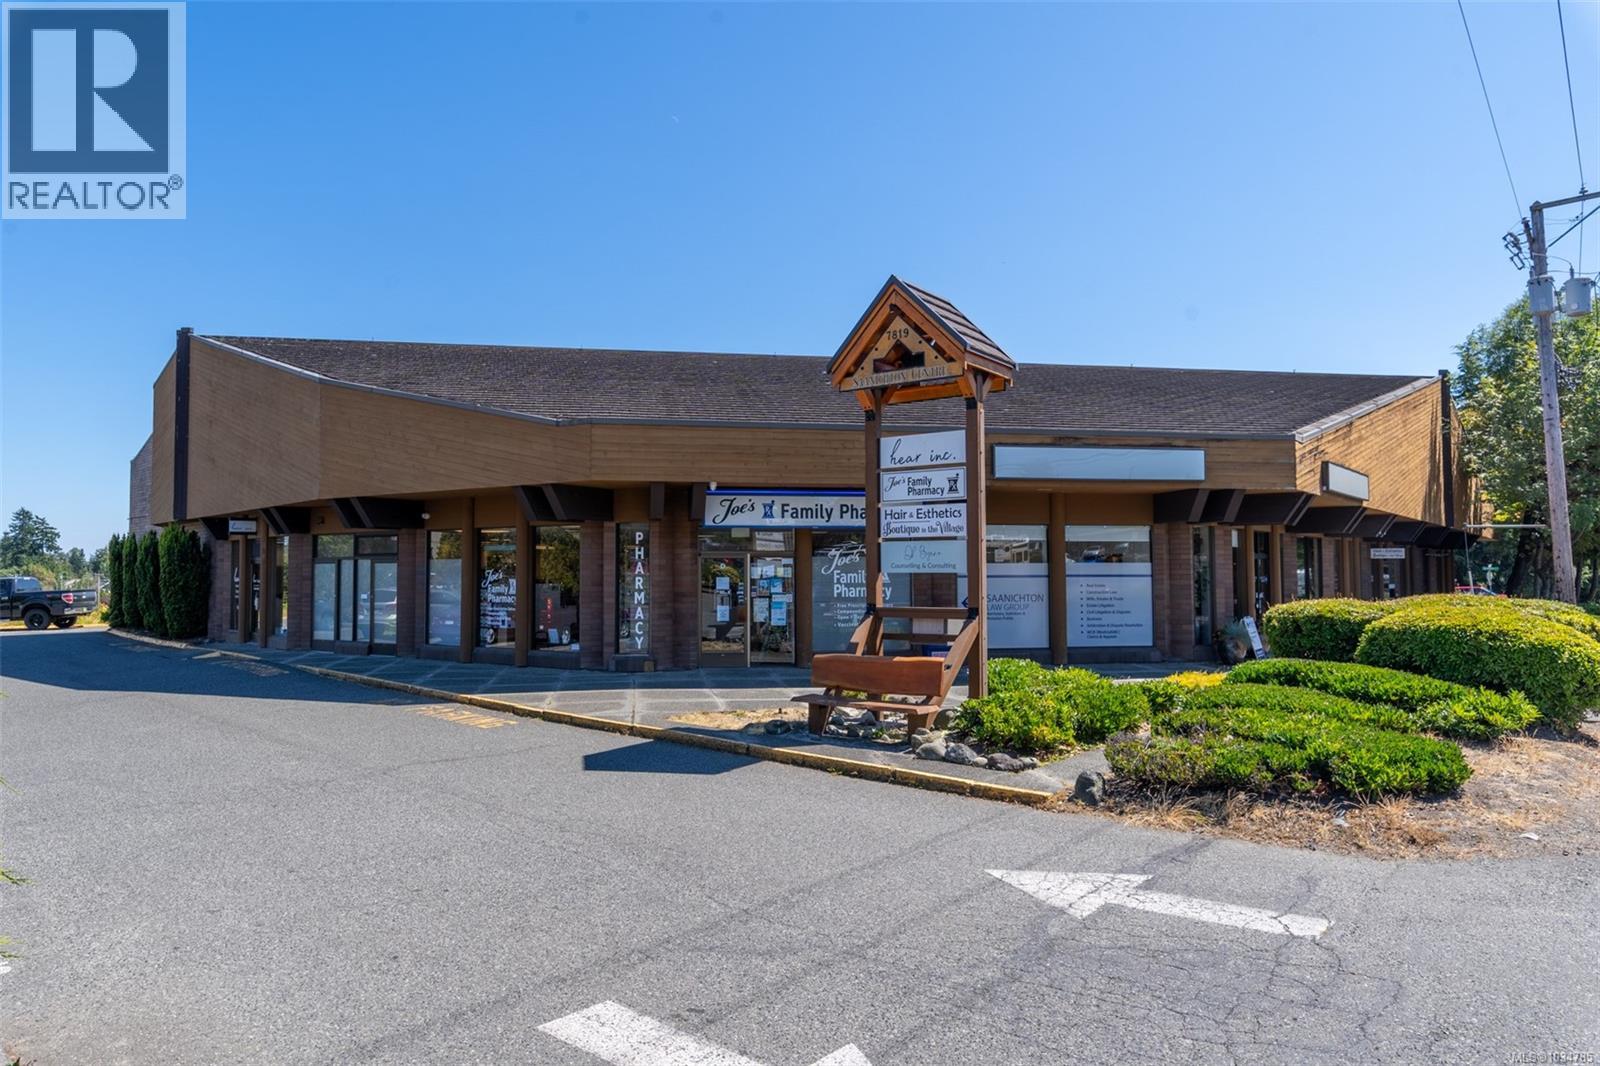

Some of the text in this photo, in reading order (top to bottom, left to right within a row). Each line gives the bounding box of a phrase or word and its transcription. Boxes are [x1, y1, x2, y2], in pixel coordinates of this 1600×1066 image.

[886, 328, 910, 340] 7819
[890, 438, 956, 465] hear inc.
[884, 476, 932, 493] Joe's Family
[907, 485, 945, 499] Pharmacy
[712, 497, 756, 525] Joe's
[781, 503, 833, 522] Family
[884, 509, 907, 521] Hair
[916, 507, 962, 519] Esthetics
[882, 523, 920, 536] Boutique
[928, 524, 938, 533] the
[936, 521, 964, 535] Village
[821, 547, 860, 575] Joe's
[928, 561, 957, 570] Consulting
[481, 569, 503, 588] Joe's
[833, 570, 866, 584] Famil
[487, 585, 509, 595] Family
[634, 532, 646, 650] PHARMACY
[987, 593, 1044, 603] SAANICHTON
